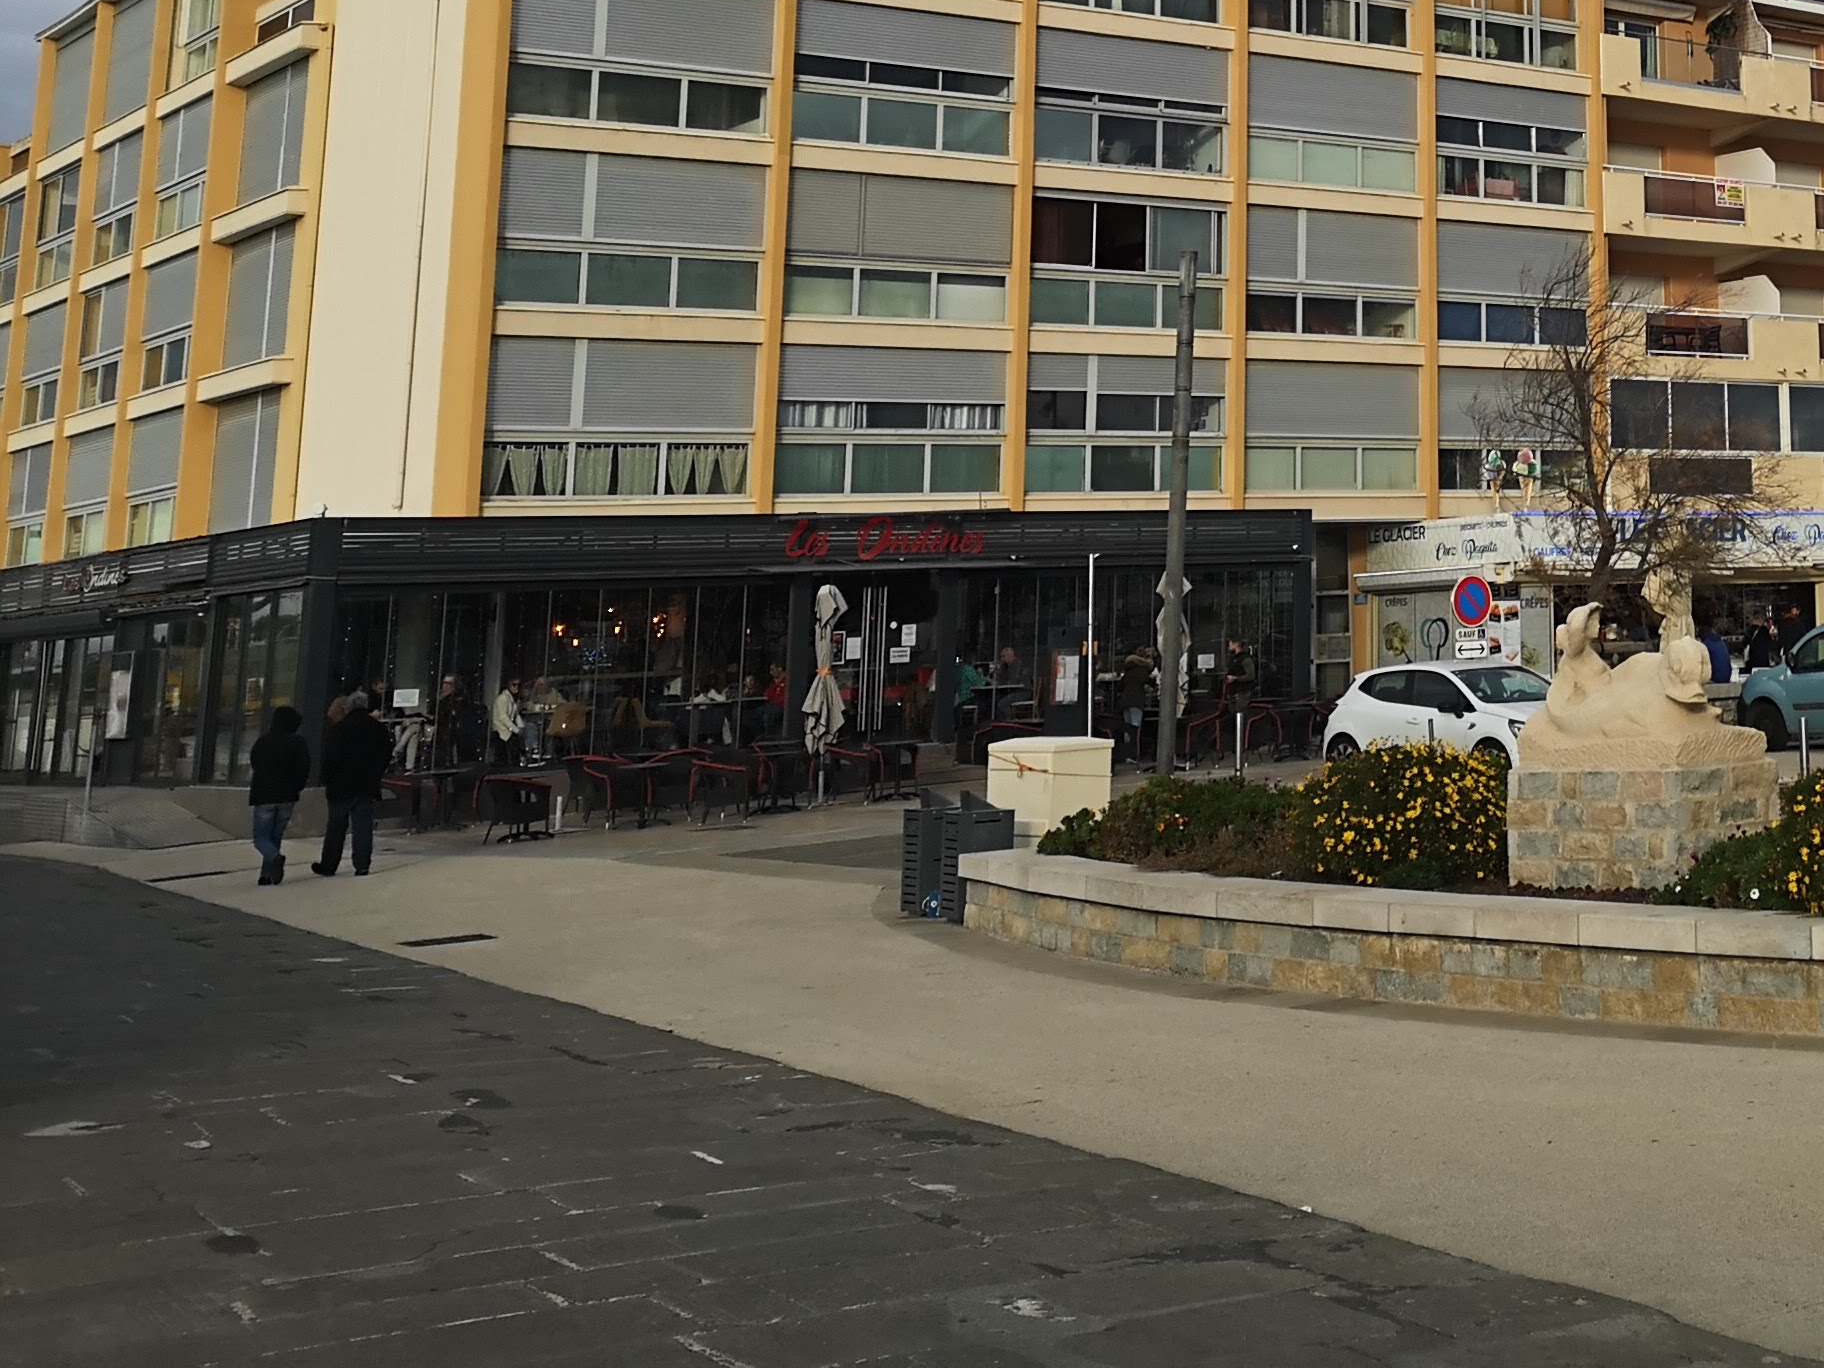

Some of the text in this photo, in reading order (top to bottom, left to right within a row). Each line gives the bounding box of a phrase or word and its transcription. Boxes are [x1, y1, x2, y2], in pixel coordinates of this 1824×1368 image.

[785, 517, 986, 561] Les Ondines
[1368, 525, 1426, 543] LE GLACIER
[1520, 594, 1549, 609] CRÊPES
[1458, 631, 1476, 639] SAUF
